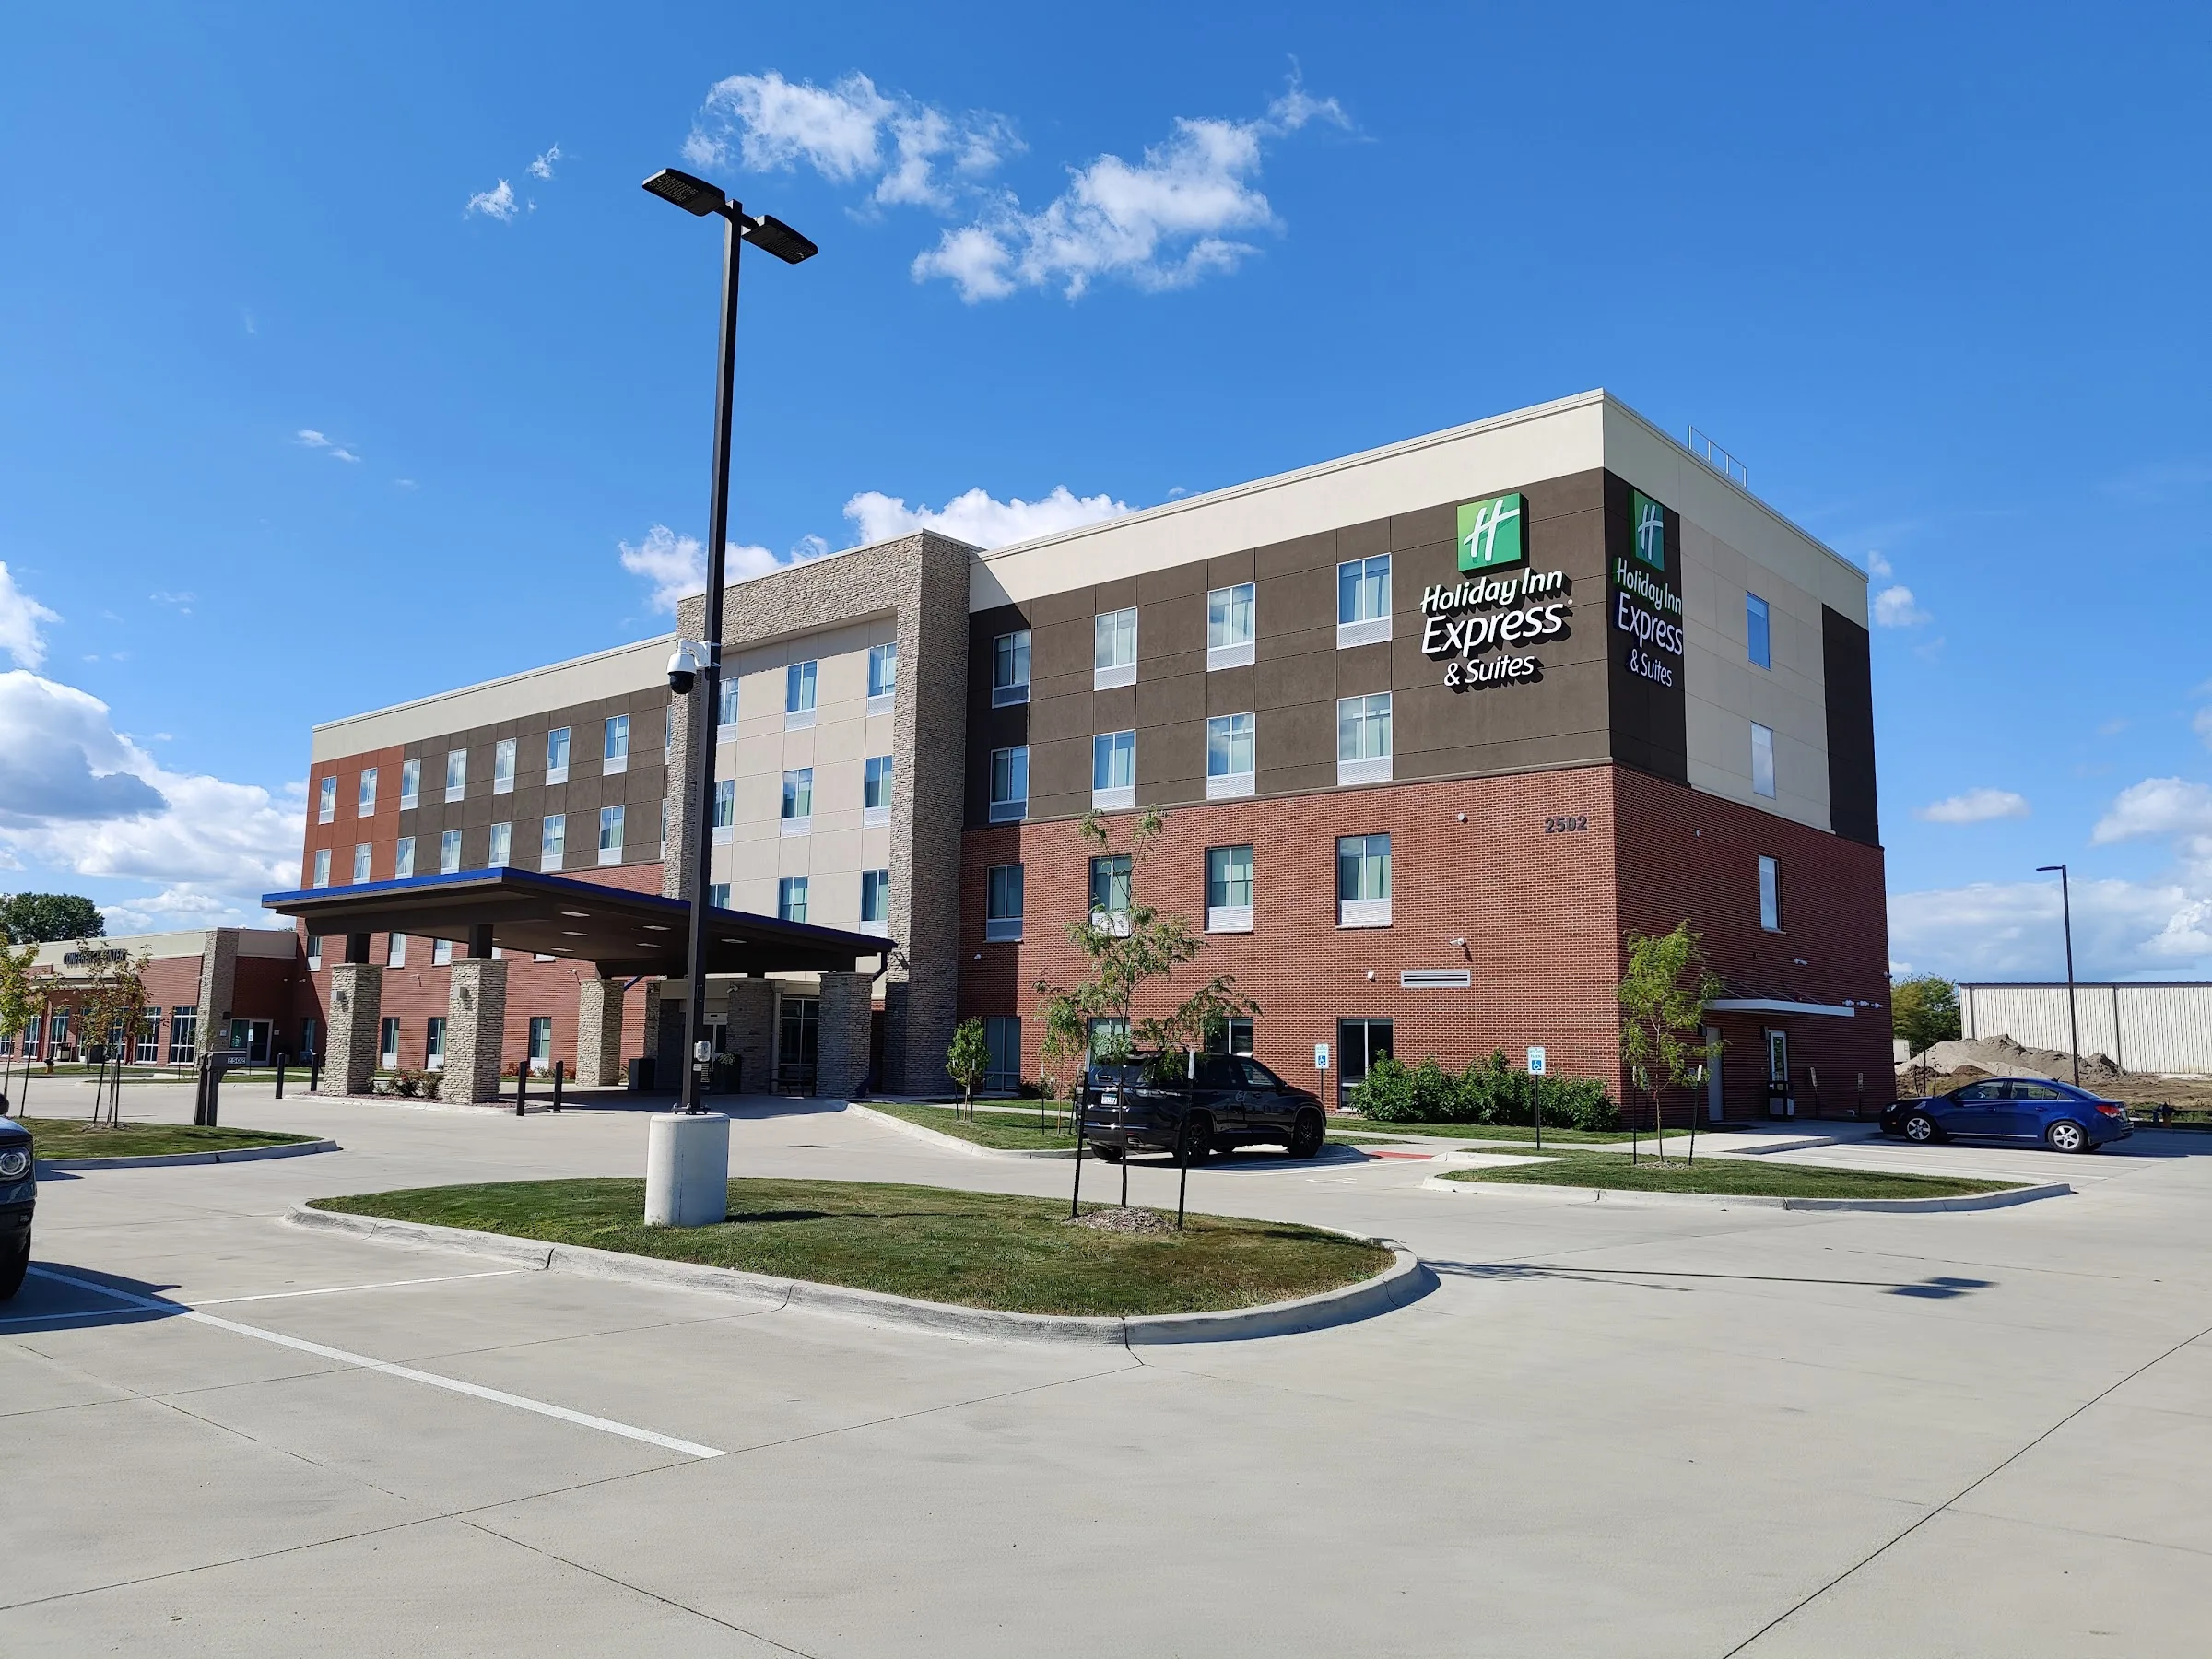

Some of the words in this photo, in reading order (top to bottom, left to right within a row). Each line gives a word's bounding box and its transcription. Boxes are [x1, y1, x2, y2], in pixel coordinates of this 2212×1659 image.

[1420, 576, 1518, 614] Holiday
[1521, 567, 1563, 595] Inn
[1616, 556, 1664, 611] Holiday
[1665, 582, 1682, 616] Inn
[1421, 603, 1564, 658] Express
[1618, 591, 1684, 656] Express
[1443, 662, 1461, 687] &
[1465, 654, 1535, 684] Suites
[1630, 648, 1640, 674] &
[1641, 653, 1673, 688] Suites
[1545, 816, 1588, 833] 2502
[227, 1056, 246, 1065] 2502
